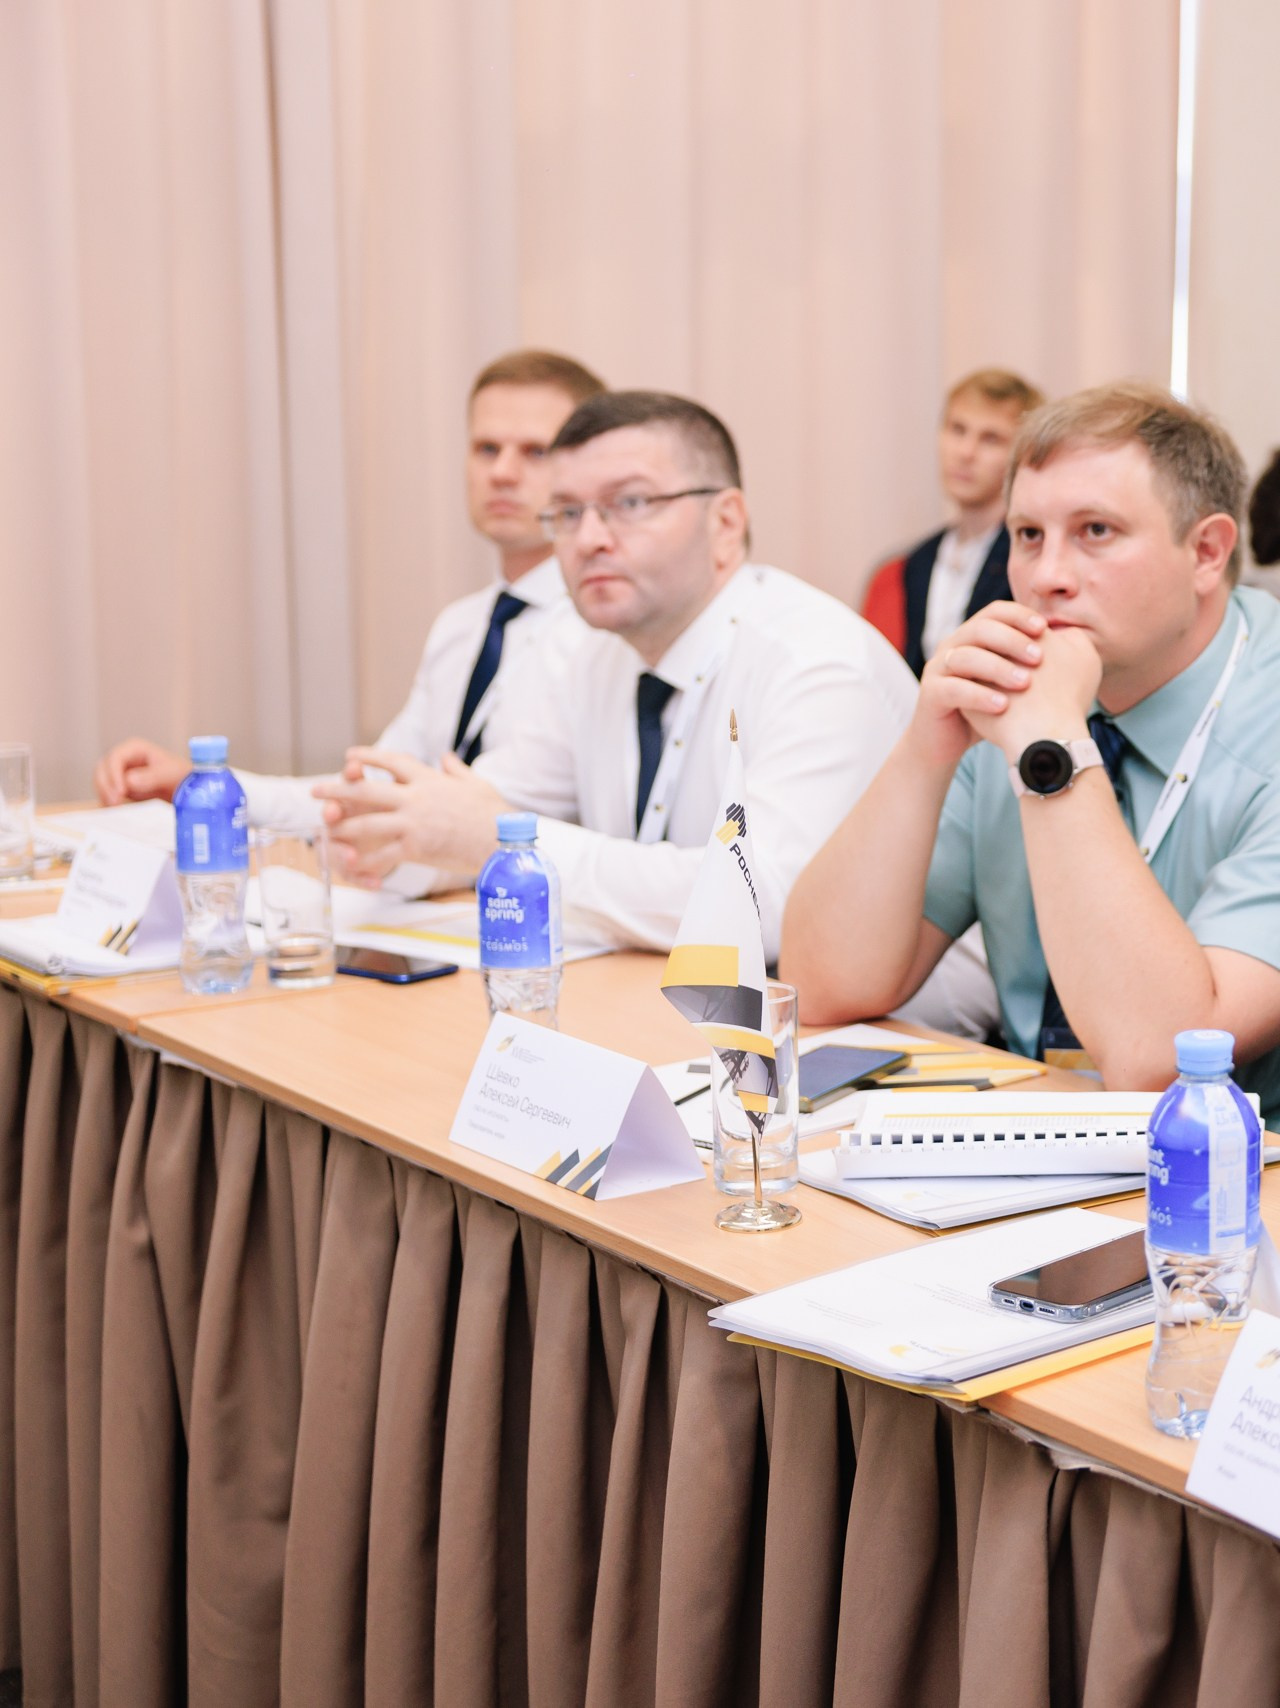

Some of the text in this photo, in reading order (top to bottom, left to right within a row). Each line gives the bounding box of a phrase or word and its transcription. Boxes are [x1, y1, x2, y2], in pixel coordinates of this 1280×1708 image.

[487, 896, 520, 909] saint
[485, 909, 525, 924] spring
[486, 940, 529, 953] COSMOS
[486, 1062, 521, 1088] Шевко
[479, 1082, 520, 1109] Алексей
[519, 1096, 572, 1129] Сергеевич
